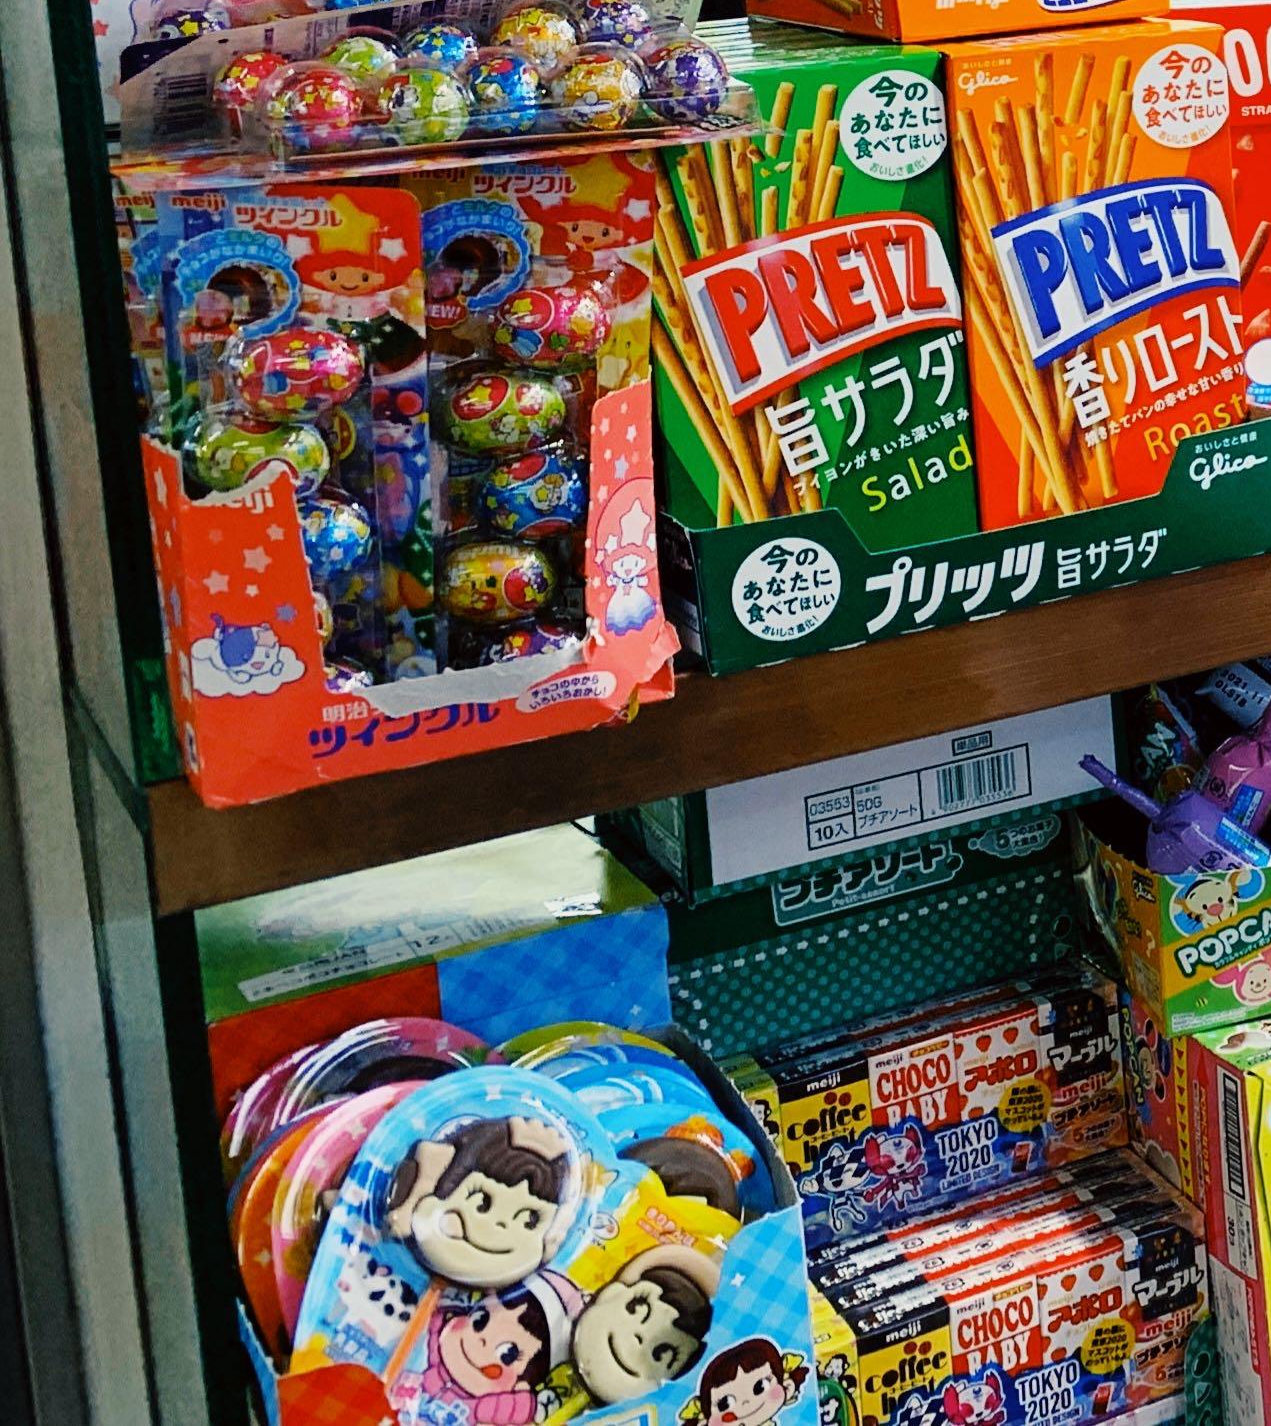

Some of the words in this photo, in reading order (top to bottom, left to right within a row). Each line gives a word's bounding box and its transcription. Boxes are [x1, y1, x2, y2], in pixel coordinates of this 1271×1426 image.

[1160, 49, 1211, 78] 今の
[869, 76, 927, 99] 今の
[1142, 81, 1225, 103] あなたに
[851, 105, 943, 134] あなたに
[1144, 102, 1228, 129] 食べてほしい
[854, 132, 946, 159] 食べてほしい
[171, 195, 226, 212] meiji
[236, 206, 342, 227] ツインクル
[1013, 186, 1226, 339] PRETZ
[705, 225, 943, 385] PRETZ
[1063, 294, 1245, 430] 香りロースト
[766, 331, 965, 478] 旨サラダ
[1144, 391, 1245, 463] Roast
[860, 435, 973, 513] Salad
[1189, 451, 1268, 490] Glico
[865, 541, 1044, 633] プリッツ
[1056, 529, 1167, 589] 旨サラダ
[810, 796, 850, 816] 03553
[857, 796, 882, 813] 50G
[858, 804, 917, 829] プチアソート
[814, 823, 848, 841] 10入
[964, 1050, 1037, 1093] アポロ
[1049, 1035, 1118, 1072] マーブル
[876, 1053, 950, 1103] CHOCO
[787, 1102, 867, 1141] coffee
[937, 1119, 998, 1156] TOKYO
[948, 1145, 991, 1173] 2020
[1134, 1263, 1204, 1307] マーブル
[958, 1296, 1033, 1350] CHOCO
[1047, 1286, 1123, 1333] アポロ
[865, 1350, 947, 1395] coffee
[1018, 1363, 1077, 1400] TOKYO
[1028, 1390, 1071, 1423] 2020
